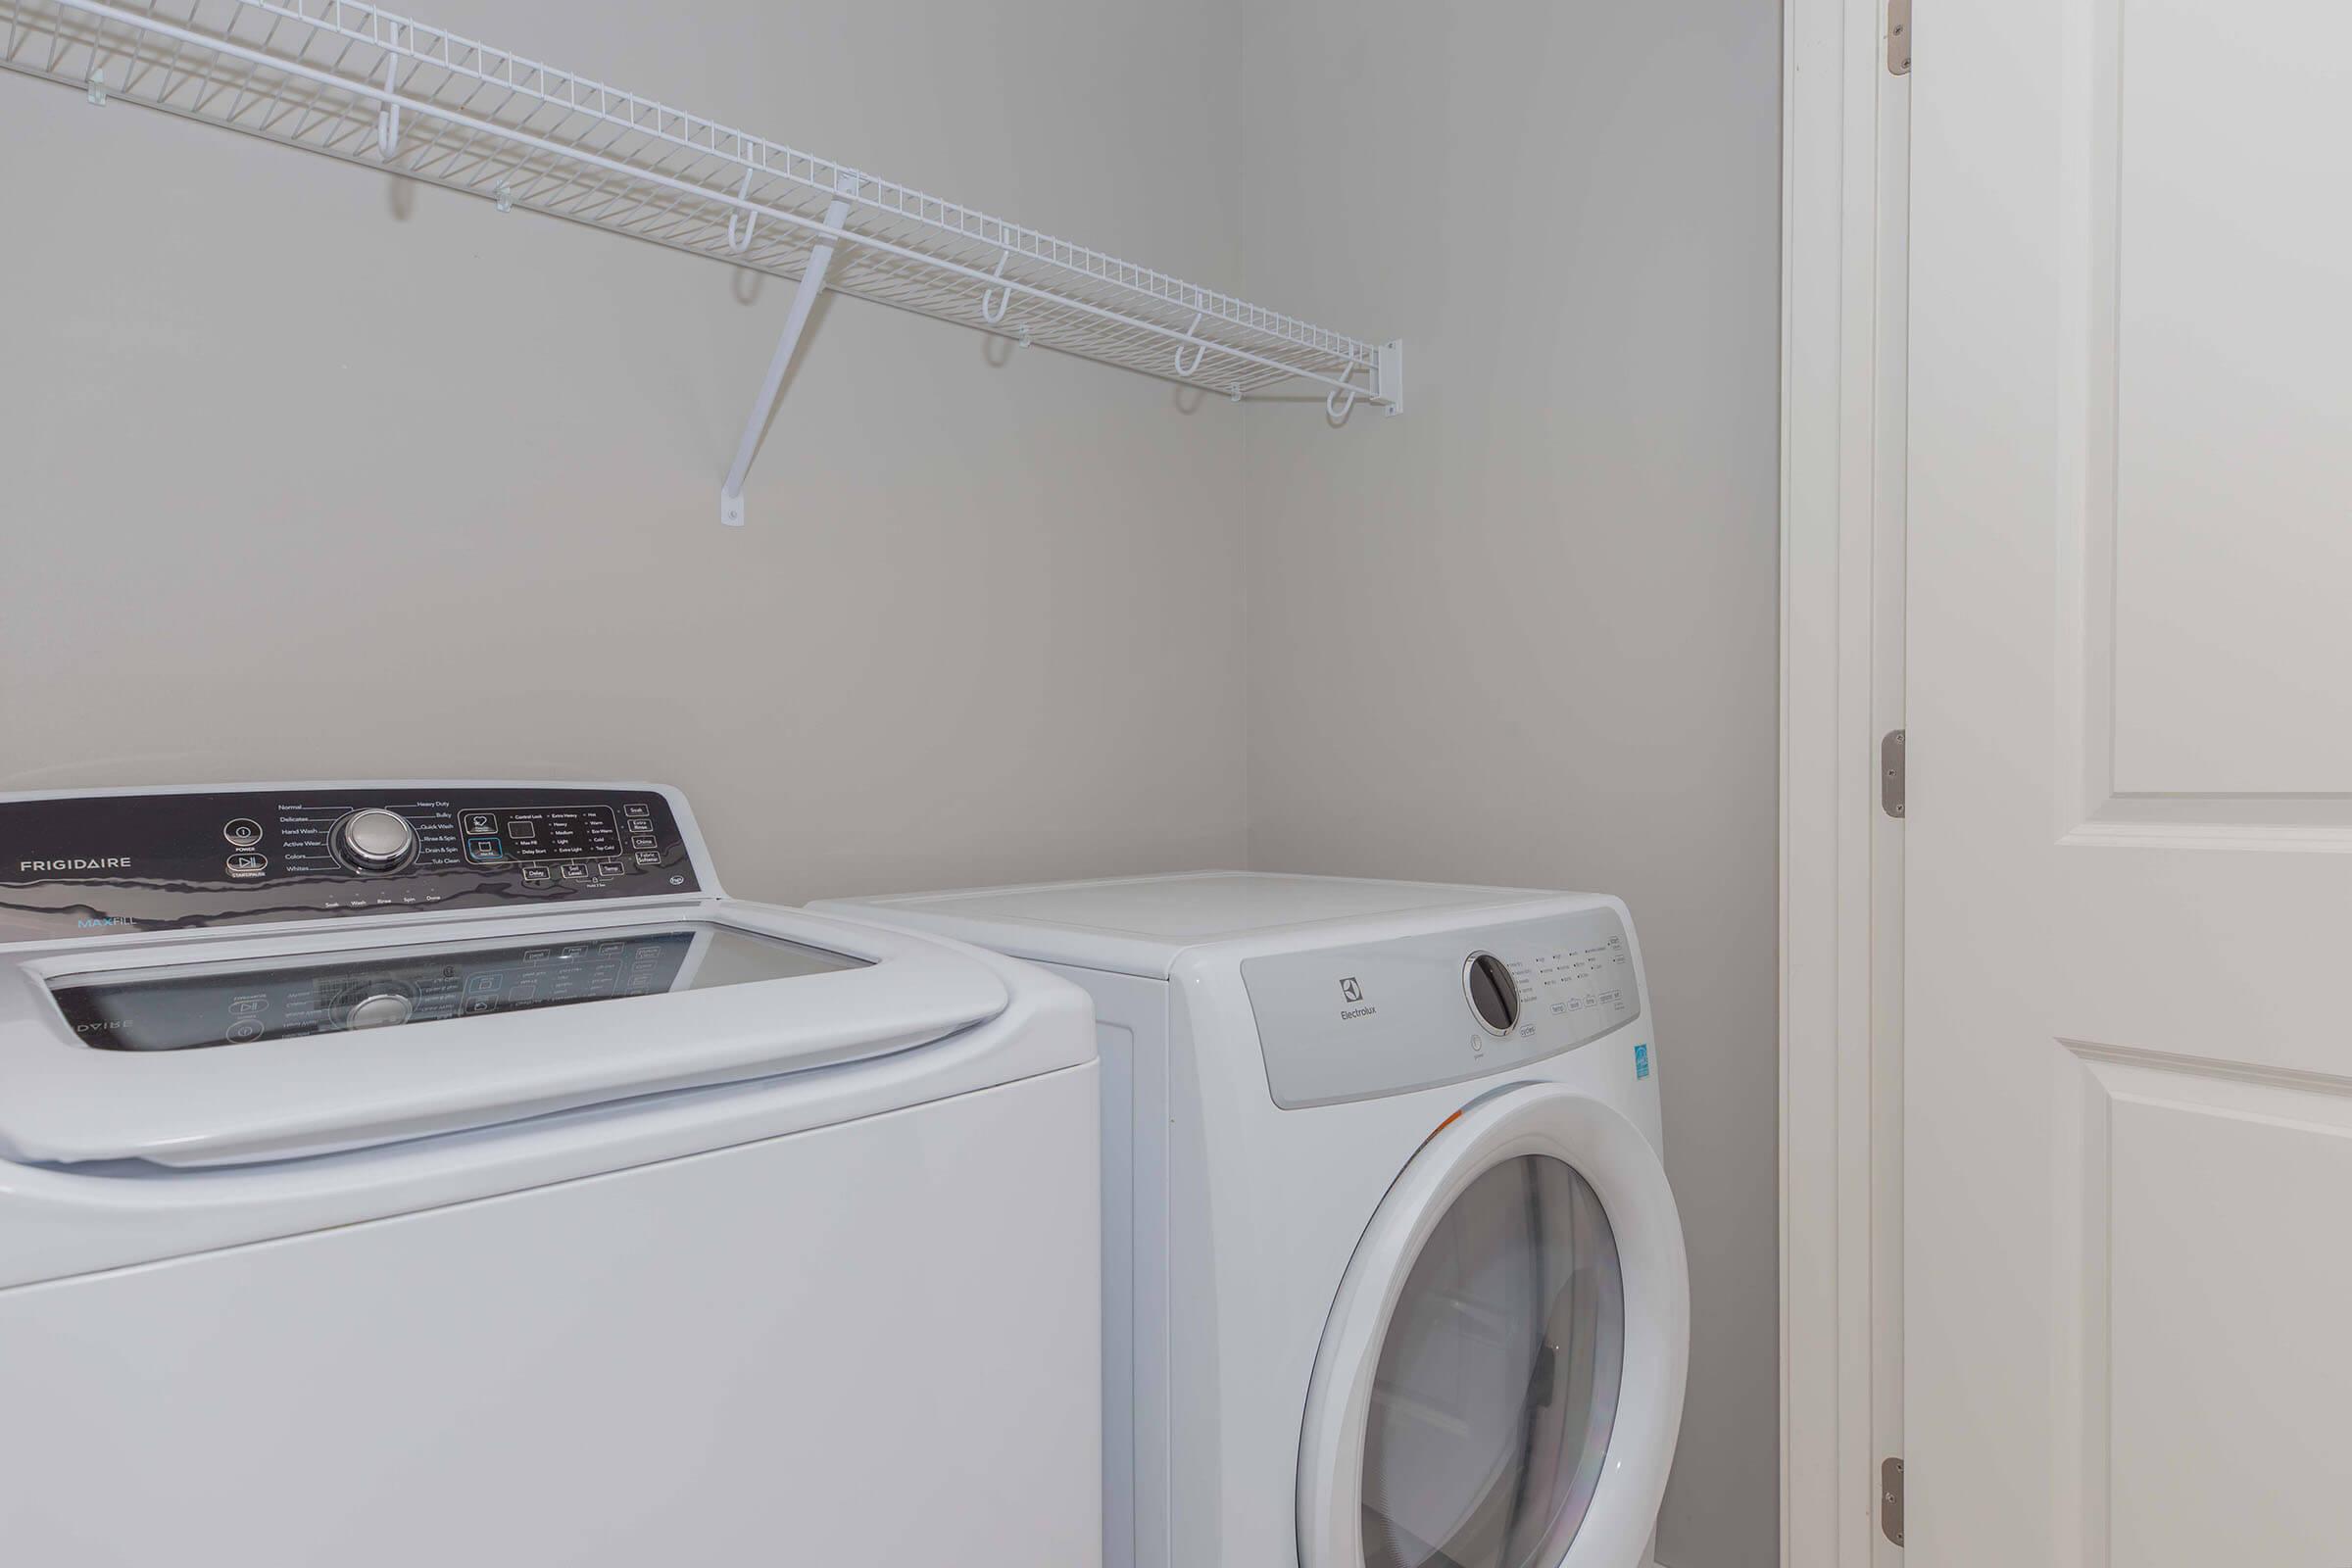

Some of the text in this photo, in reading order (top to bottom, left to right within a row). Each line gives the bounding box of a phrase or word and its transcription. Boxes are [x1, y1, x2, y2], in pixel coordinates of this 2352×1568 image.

[20, 857, 132, 871] FRIGIDAIRE
[77, 916, 137, 929] MAXFILL
[1340, 1006, 1377, 1020] Electrolux
